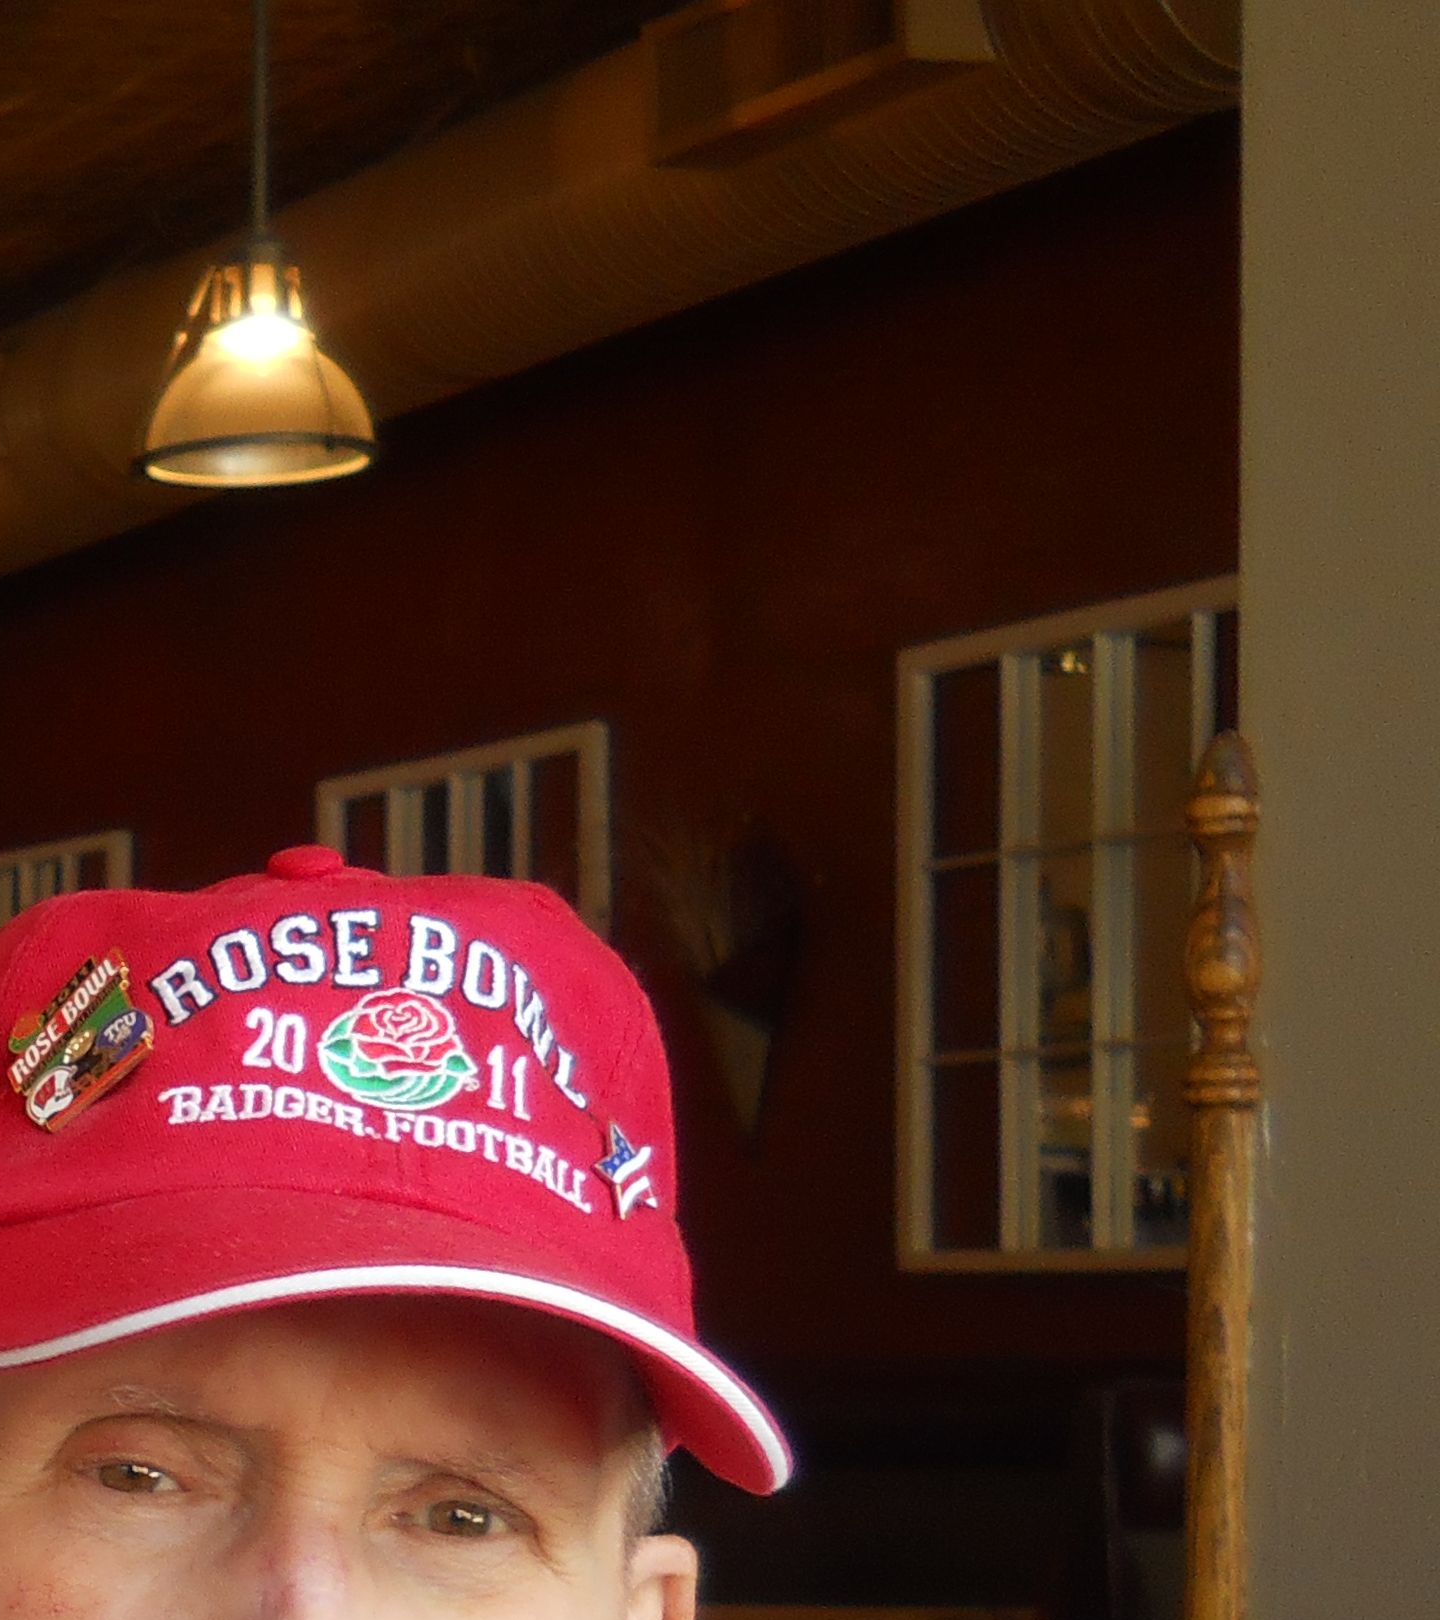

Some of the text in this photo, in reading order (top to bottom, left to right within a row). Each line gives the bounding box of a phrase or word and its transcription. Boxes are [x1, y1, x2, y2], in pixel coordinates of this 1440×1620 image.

[8, 957, 119, 1086] ROSE BOWL
[102, 1010, 138, 1042] TCU
[148, 906, 588, 1110] ROSE BOWL
[241, 1005, 532, 1122] 20 11
[157, 1082, 593, 1215] BADGER FOOTBALL
